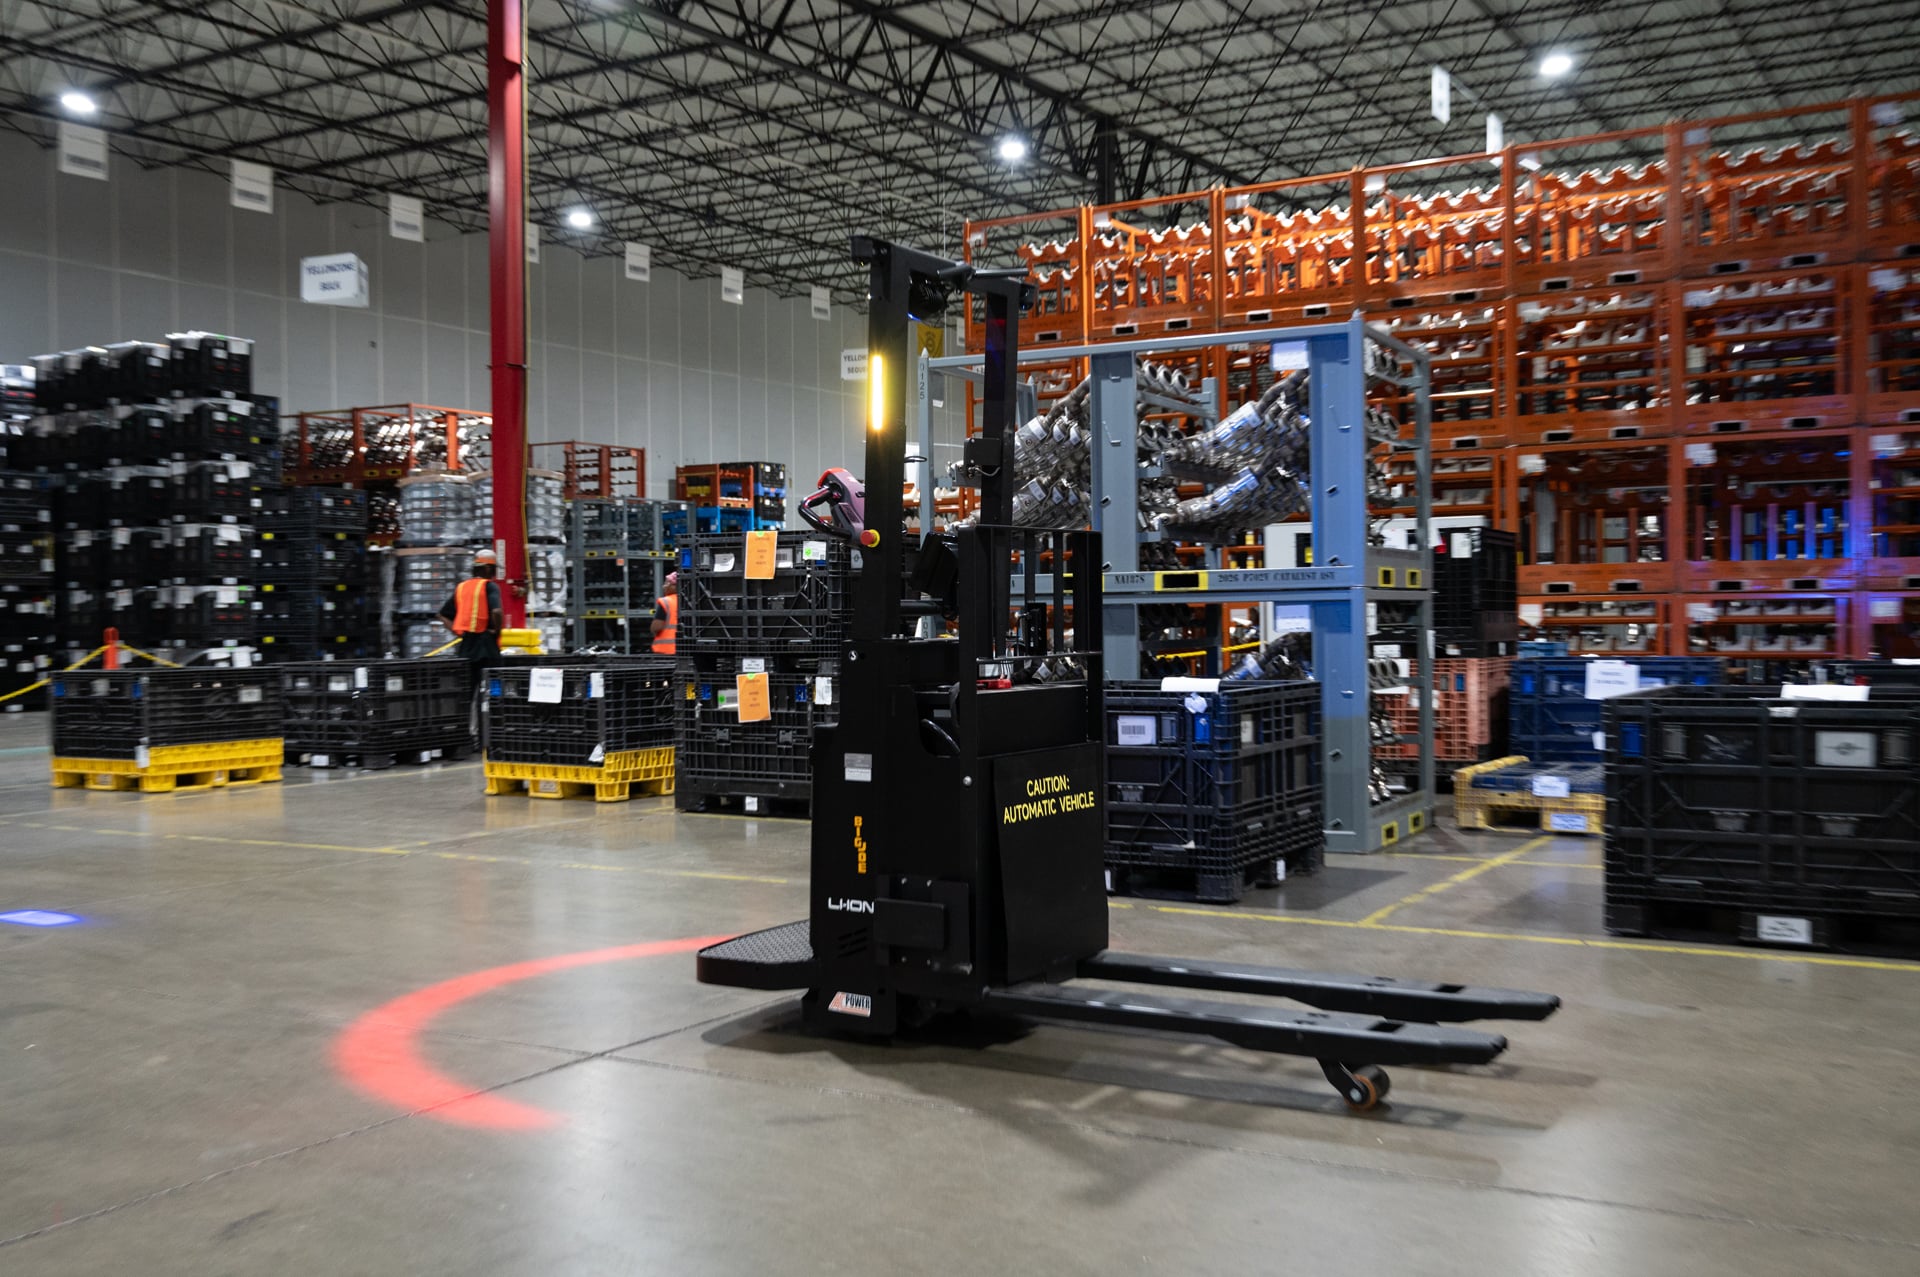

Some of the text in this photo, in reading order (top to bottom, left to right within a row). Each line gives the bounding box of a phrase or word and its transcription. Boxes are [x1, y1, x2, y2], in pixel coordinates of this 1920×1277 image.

[1026, 774, 1070, 797] CAUTION:
[1003, 791, 1095, 825] AUTOMATIC VEHICLE
[845, 993, 871, 1009] POWER
